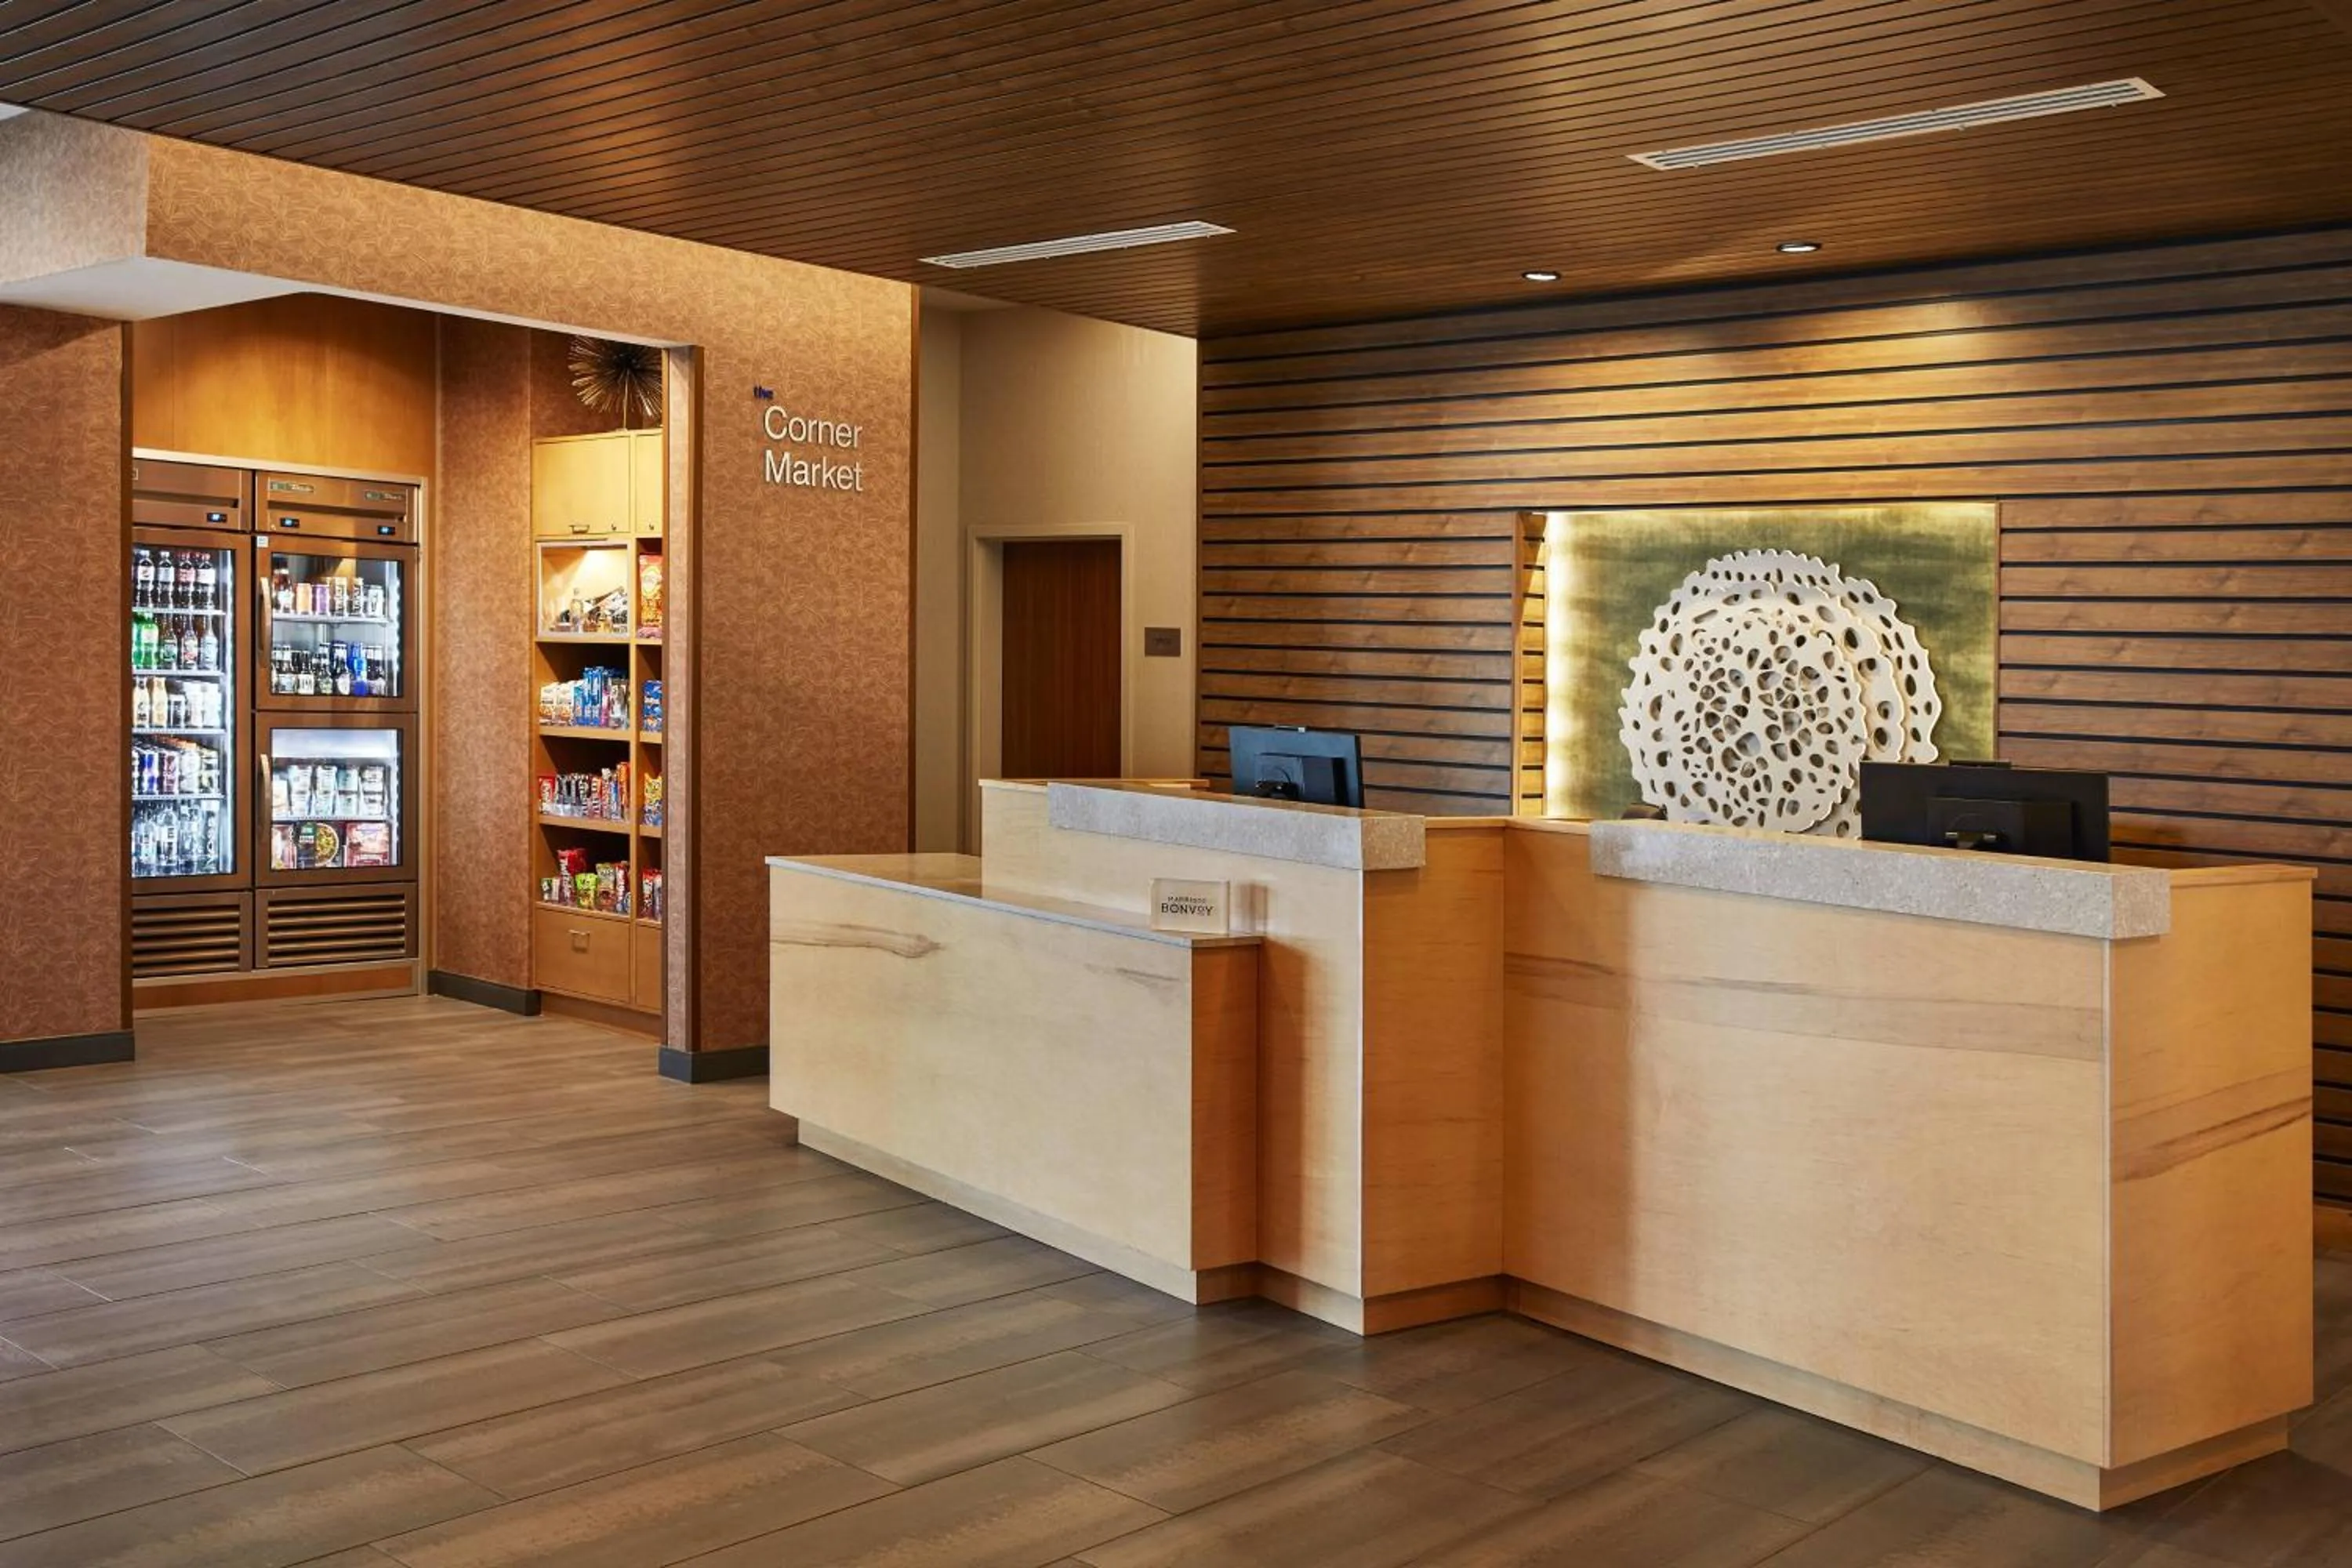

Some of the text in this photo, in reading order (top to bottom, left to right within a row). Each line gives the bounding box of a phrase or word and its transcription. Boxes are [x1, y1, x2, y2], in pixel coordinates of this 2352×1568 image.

[753, 385, 774, 401] the
[764, 405, 863, 448] Corner
[765, 449, 863, 492] Market
[1161, 902, 1214, 916] BONVOY
